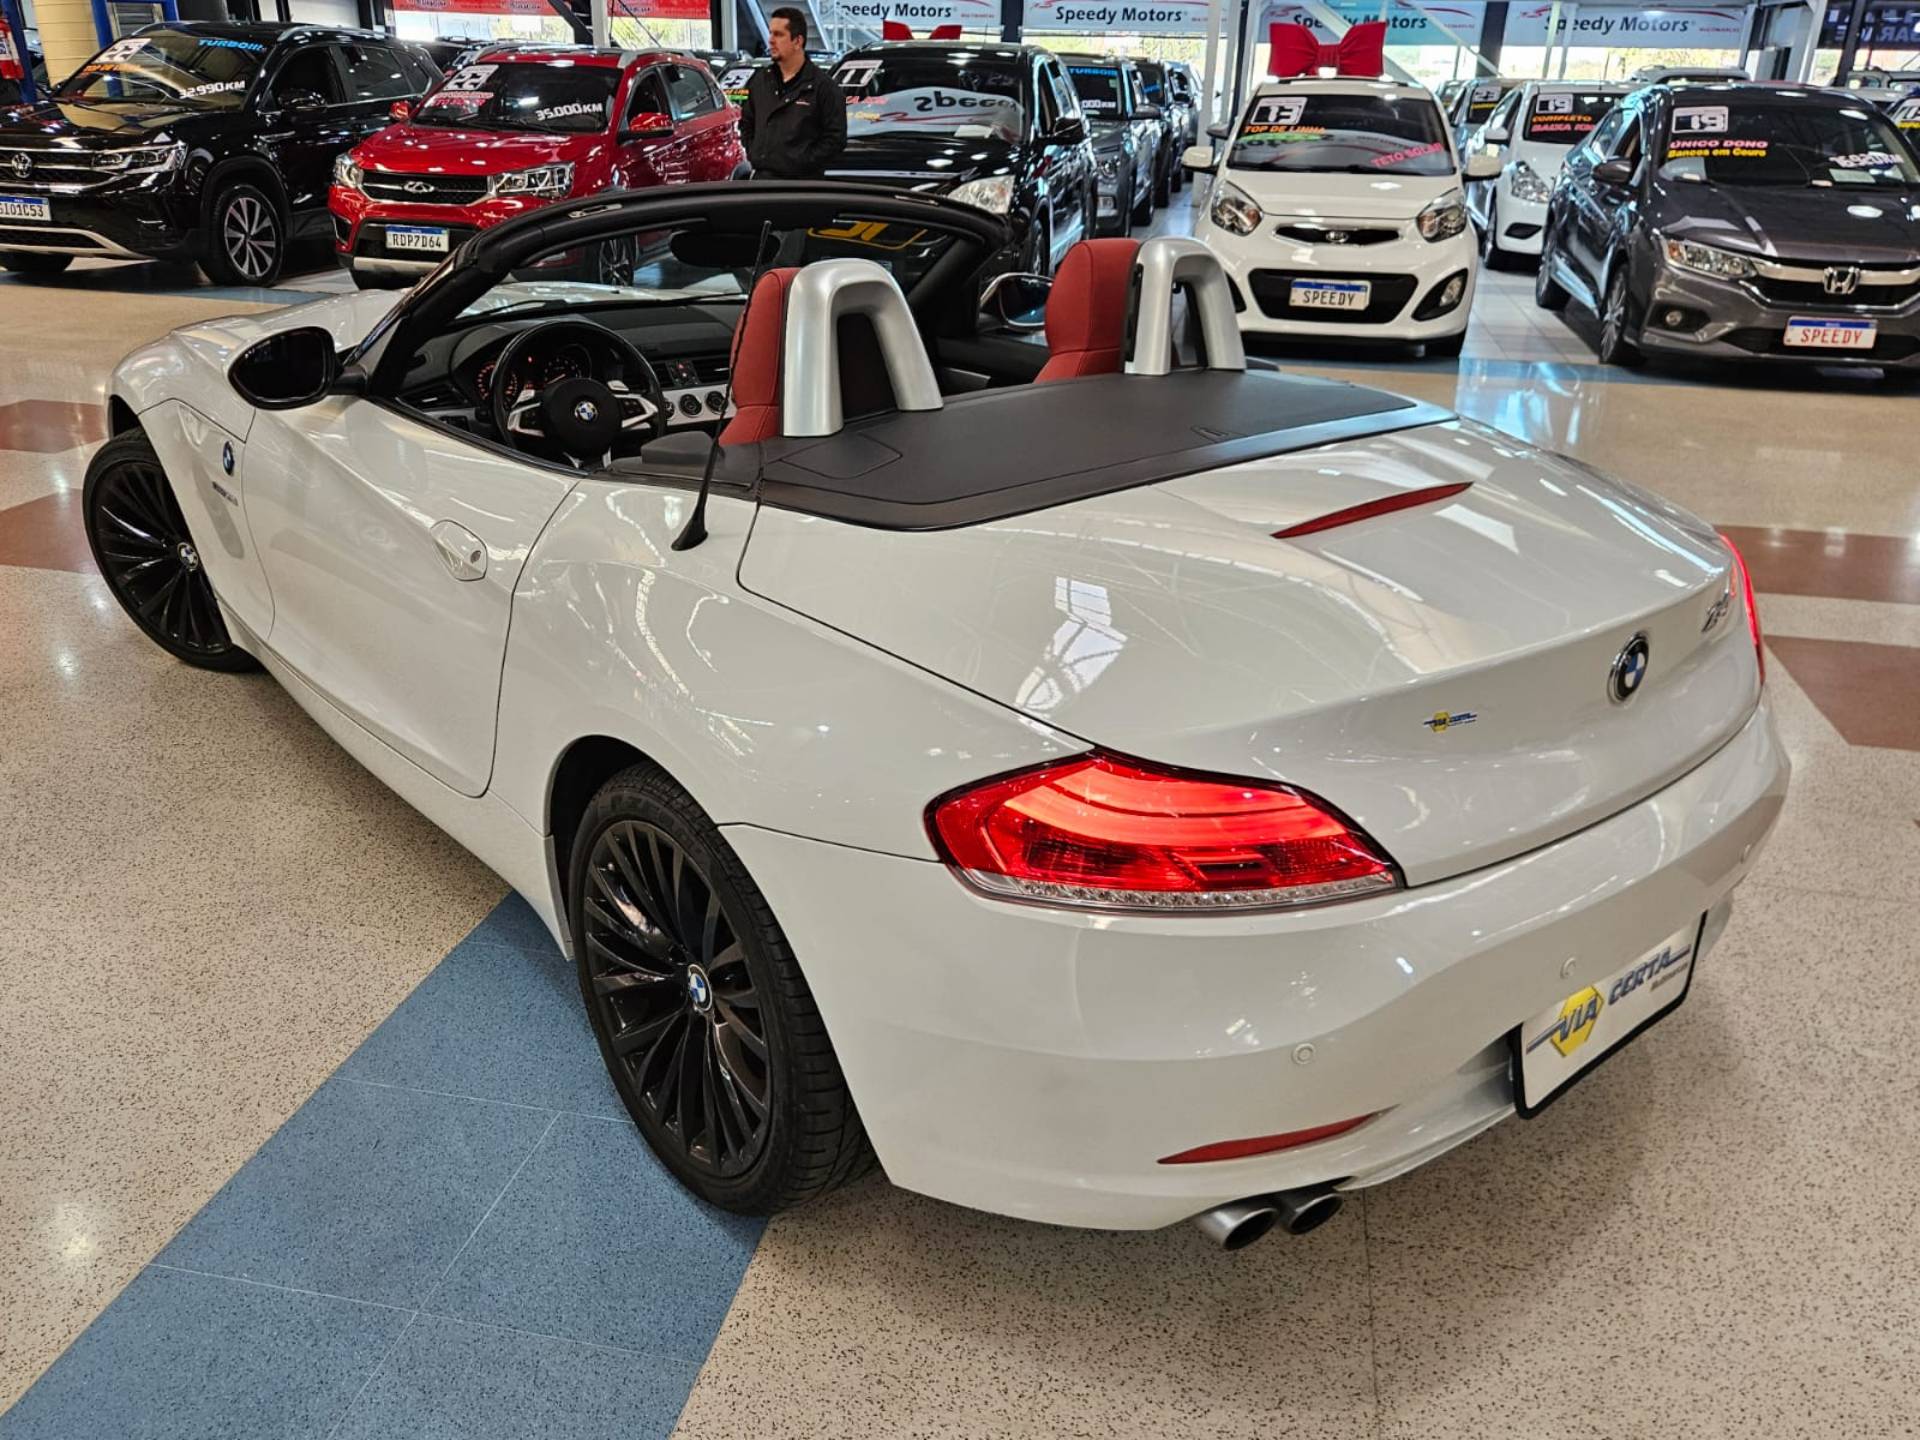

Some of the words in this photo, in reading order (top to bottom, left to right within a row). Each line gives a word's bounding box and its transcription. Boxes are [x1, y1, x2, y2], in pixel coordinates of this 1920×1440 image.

[895, 3, 952, 18] Motors
[1056, 6, 1117, 25] Speedy
[1122, 7, 1182, 22] Motors
[1619, 16, 1690, 33] Motors
[1244, 125, 1268, 134] TOP
[1269, 125, 1287, 134] DE
[1667, 148, 1710, 158] Bancos
[1711, 149, 1730, 157] em
[1732, 147, 1768, 158] Couro
[1722, 140, 1769, 149] DONO
[1371, 152, 1405, 168] TETO
[1302, 290, 1356, 307] SPEEDY
[1801, 327, 1864, 345] SPEEDY
[1552, 995, 1598, 1043] VIA
[1608, 946, 1674, 1006] CERTA
